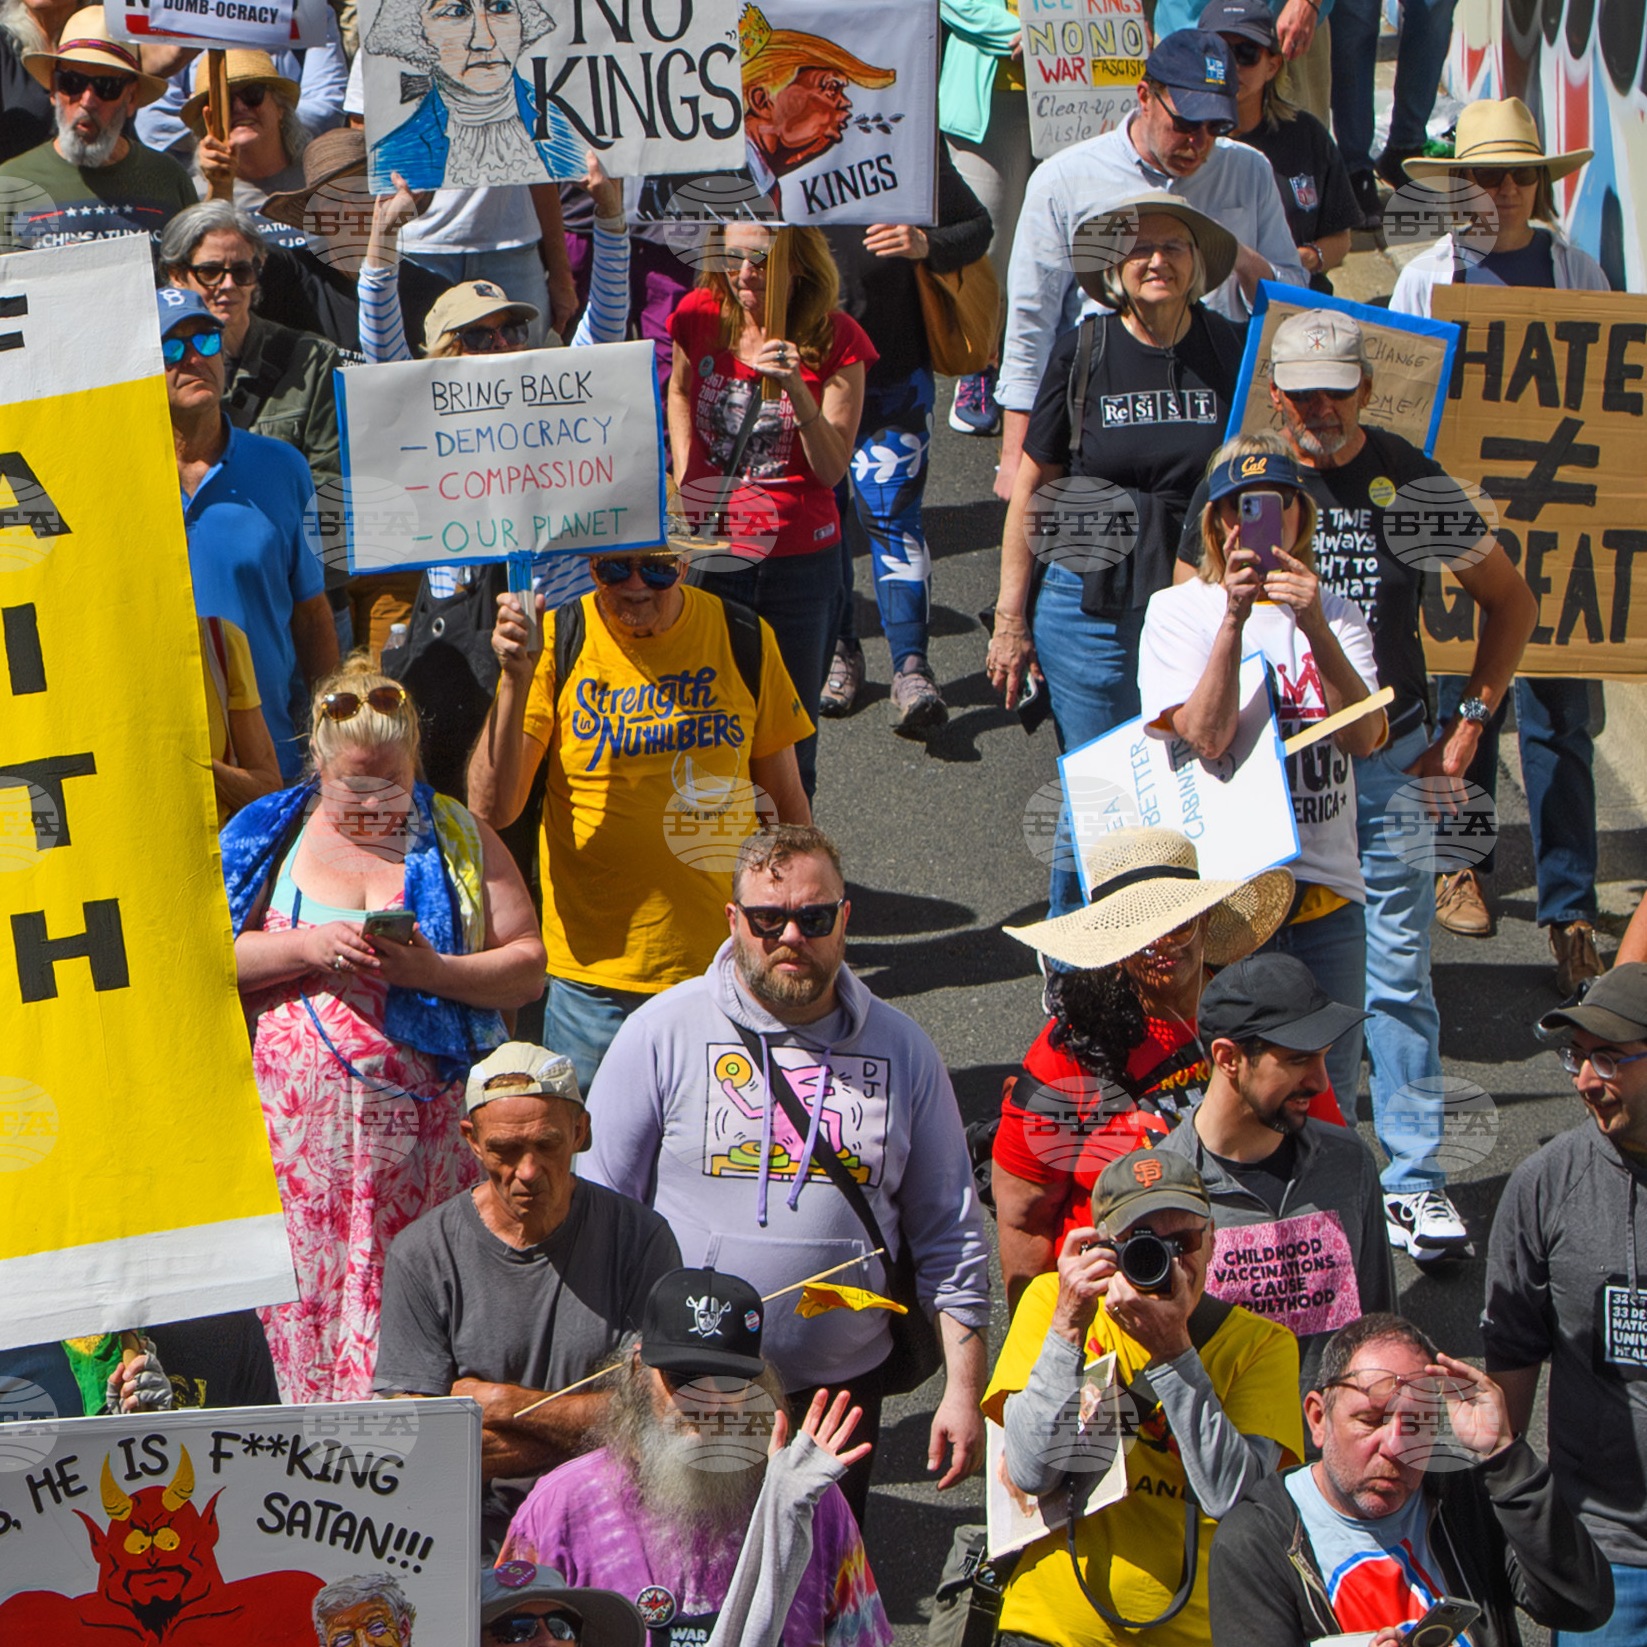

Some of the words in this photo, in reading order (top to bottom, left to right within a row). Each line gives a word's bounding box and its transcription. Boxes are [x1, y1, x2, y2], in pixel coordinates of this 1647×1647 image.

[1037, 56, 1088, 85] WAR
[800, 153, 899, 218] KINGS
[1362, 337, 1430, 368] CHANGE
[1449, 322, 1646, 415] HATE
[431, 380, 513, 412] BRING
[520, 370, 593, 404] BACK
[435, 416, 613, 459] DEMOCRACY
[438, 456, 615, 500] COMPASSION
[1241, 456, 1267, 477] Cal
[441, 518, 518, 553] OUR
[532, 507, 629, 541] PLANET
[572, 665, 717, 733] Strength
[1214, 1255, 1336, 1283] VACCINATIONS
[1224, 1238, 1322, 1265] CHILDHOOD
[1251, 1277, 1308, 1298] CAUSE
[26, 1455, 89, 1516] HE
[115, 1434, 169, 1479] IS
[256, 1492, 435, 1574] SATAN!!!
